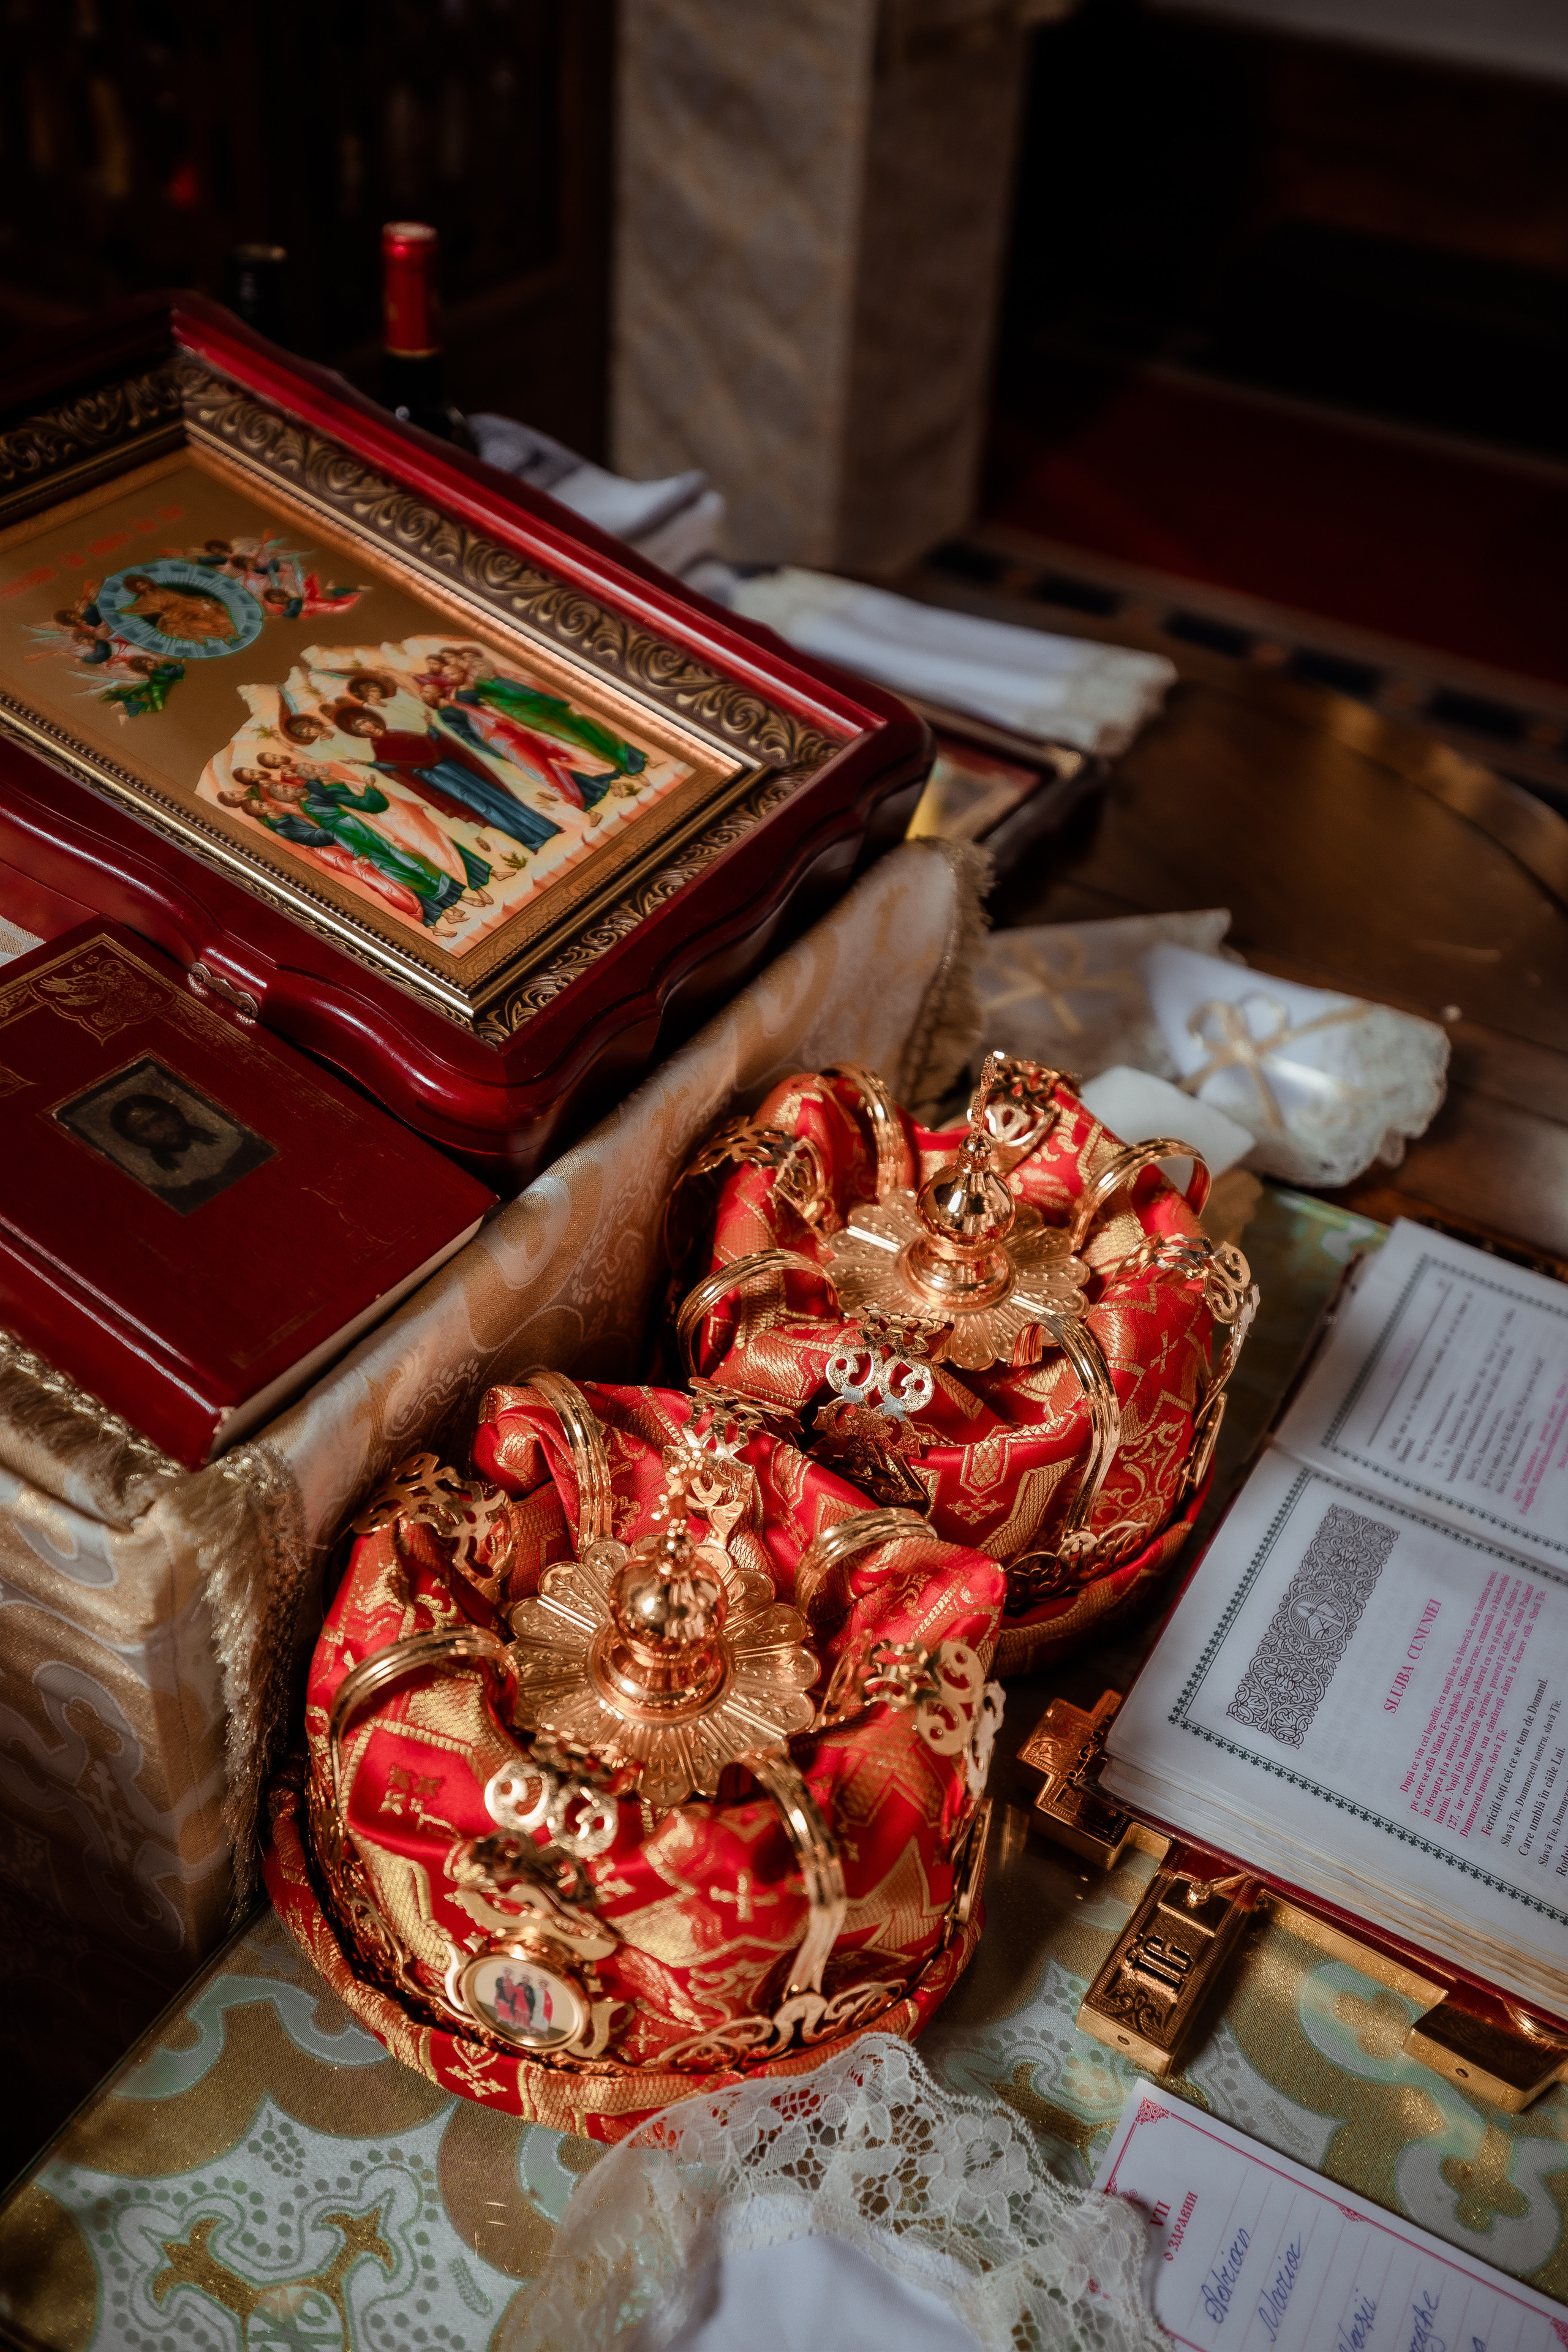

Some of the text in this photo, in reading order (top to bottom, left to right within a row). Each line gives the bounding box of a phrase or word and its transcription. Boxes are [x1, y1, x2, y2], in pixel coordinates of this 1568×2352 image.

[1515, 1579, 1523, 1588] cu
[1489, 1604, 1498, 1613] (a
[1470, 1611, 1481, 1627] stau
[1383, 1597, 1442, 1714] SLUJBA CUNUNIEI
[1487, 1644, 1497, 1655] vin
[1452, 1656, 1463, 1665] în
[1483, 1656, 1492, 1666] cu
[1457, 1665, 1474, 1689] Sfânta
[1472, 1665, 1488, 1696] paharul
[1438, 1695, 1447, 1705] cu
[1453, 1798, 1466, 1812] iar
[1480, 1735, 1490, 1750] sau
[1500, 1675, 1513, 1696] cântă
[1507, 1665, 1518, 1674] la
[1528, 1602, 1542, 1621] Slavă
[1458, 1719, 1482, 1760] lumânările
[1489, 1661, 1504, 1690] preotul
[1454, 1724, 1465, 1733] la
[1523, 1715, 1534, 1727] de
[1420, 1734, 1430, 1747] cei
[1430, 1732, 1447, 1757] Sfânta
[1516, 1728, 1530, 1746] tem
[1414, 1747, 1425, 1760] vin
[1445, 1732, 1461, 1762] miresei
[1513, 1747, 1522, 1757] se
[1411, 1761, 1419, 1771] ce
[1425, 1756, 1436, 1773] află
[1509, 1758, 1518, 1769] ce
[1399, 1770, 1415, 1793] După
[1422, 1773, 1430, 1782] se
[1500, 1823, 1516, 1847] Slavă
[1515, 1761, 1539, 1807] Dumnezeul
[1543, 1713, 1556, 1735] slavă
[1503, 1768, 1514, 1784] cei
[1544, 1766, 1558, 1789] căile
[1414, 1782, 1426, 1800] care
[1425, 1777, 1444, 1807] dreapta
[1459, 1792, 1483, 1838] Dumnezeul
[1488, 1743, 1502, 1765] slavă
[1537, 1790, 1550, 1801] în
[1409, 1800, 1419, 1812] pe
[1420, 1808, 1431, 1818] în
[1529, 1800, 1546, 1831] umblă
[1537, 1843, 1553, 1868] Slavă
[1551, 1780, 1568, 1827] Dumneze
[1518, 1833, 1534, 1856] Care
[1149, 2199, 1171, 2227] VII
[1167, 2190, 1199, 2252] ЗДРАВИИ
[1200, 2228, 1251, 2324] Adrian
[1258, 2231, 1302, 2343] Maria
